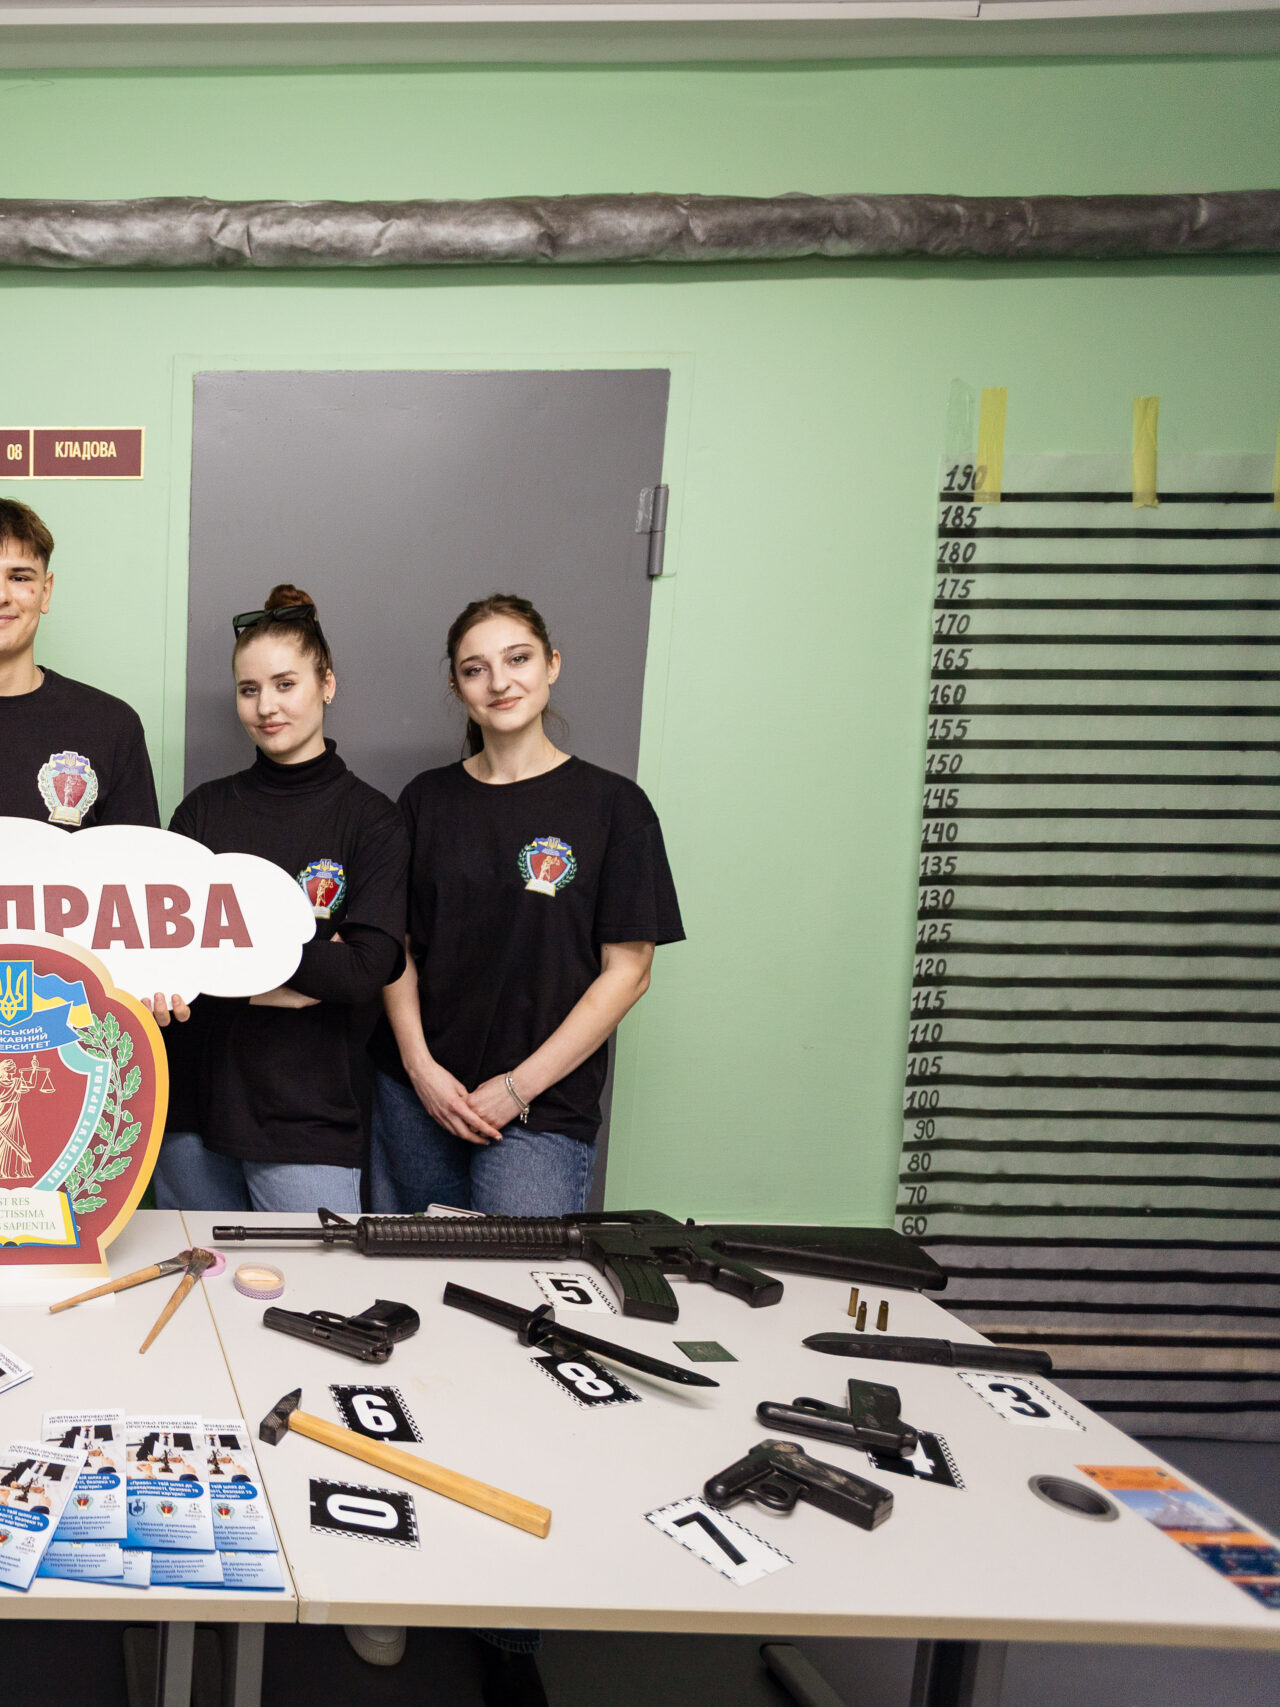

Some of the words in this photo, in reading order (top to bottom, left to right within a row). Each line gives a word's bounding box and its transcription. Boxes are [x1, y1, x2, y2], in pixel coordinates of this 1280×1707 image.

[7, 444, 22, 460] 08
[55, 440, 117, 459] КЛАДОВА
[943, 465, 987, 491] 190
[939, 506, 982, 528] 185
[937, 542, 977, 563] 180
[936, 578, 976, 599] 175
[934, 614, 971, 635] 170
[931, 648, 973, 670] 165
[929, 684, 967, 705] 160
[928, 719, 971, 740] 155
[925, 754, 963, 774] 150
[923, 788, 960, 809] 145
[922, 822, 959, 843] 140
[920, 856, 958, 876] 135
[918, 889, 955, 910] 130
[917, 923, 952, 943] 125
[915, 958, 947, 978] 120
[912, 990, 947, 1010] 115
[910, 1023, 943, 1043] 110
[907, 1056, 942, 1075] 105
[906, 1089, 940, 1109] 100
[47, 1121, 92, 1184] ІНСТИТУТ
[87, 1065, 104, 1115] ПРАВА
[914, 1119, 935, 1140] 90
[907, 1152, 932, 1172] 80
[11, 1198, 30, 1206] RES
[904, 1185, 928, 1205] 70
[3, 1222, 56, 1231] SAPIENTIA
[902, 1216, 928, 1235] 60
[549, 1278, 593, 1305] 5
[556, 1361, 615, 1397] 8
[987, 1383, 1051, 1419] 3
[351, 1393, 398, 1432] 6
[673, 1512, 748, 1567] 7
